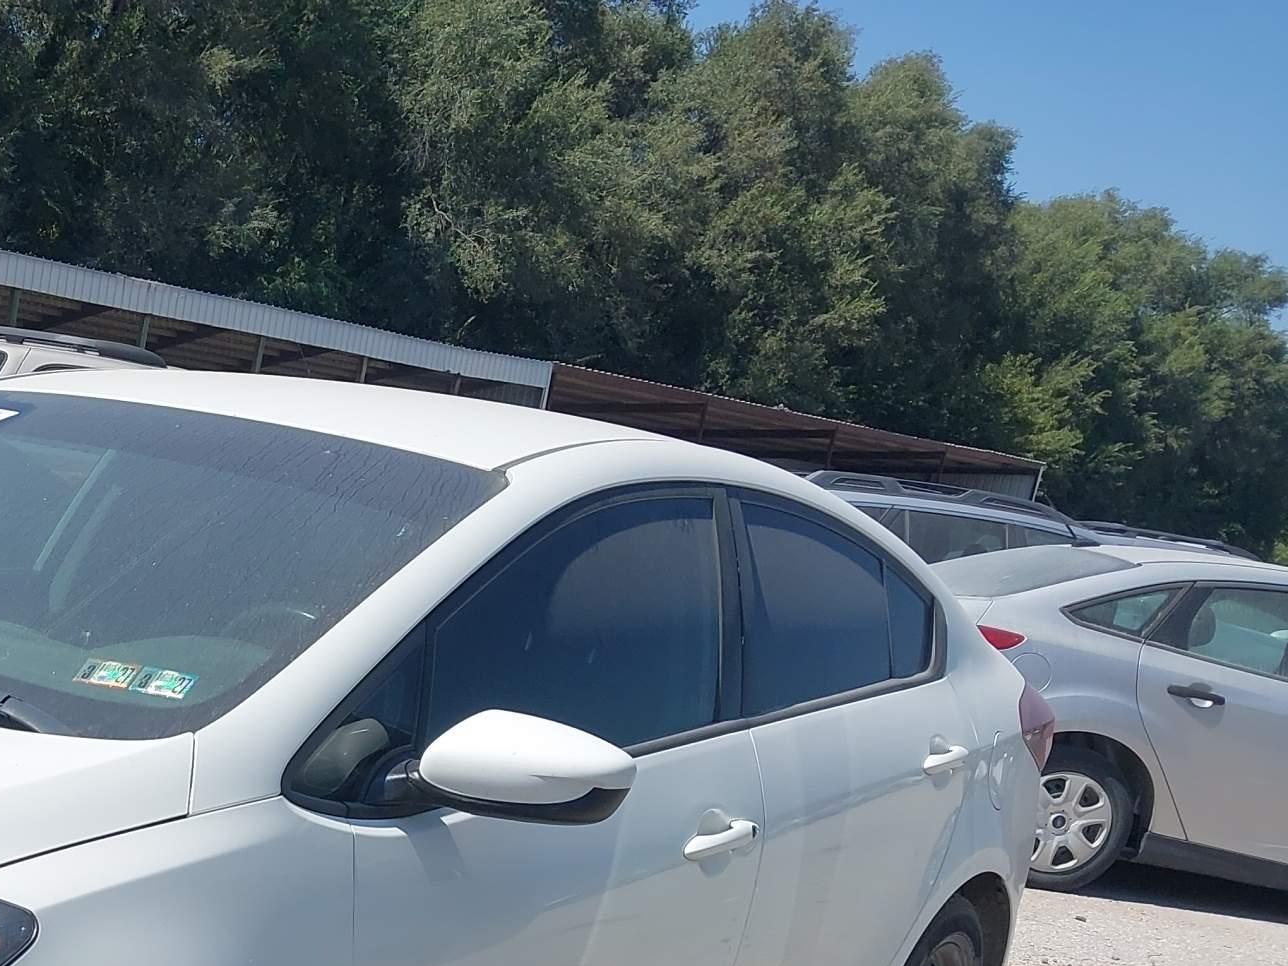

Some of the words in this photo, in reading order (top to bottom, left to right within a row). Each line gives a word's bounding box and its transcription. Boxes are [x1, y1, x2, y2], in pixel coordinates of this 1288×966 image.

[81, 664, 97, 680] 3
[138, 673, 153, 689] 3
[172, 676, 193, 694] 27
